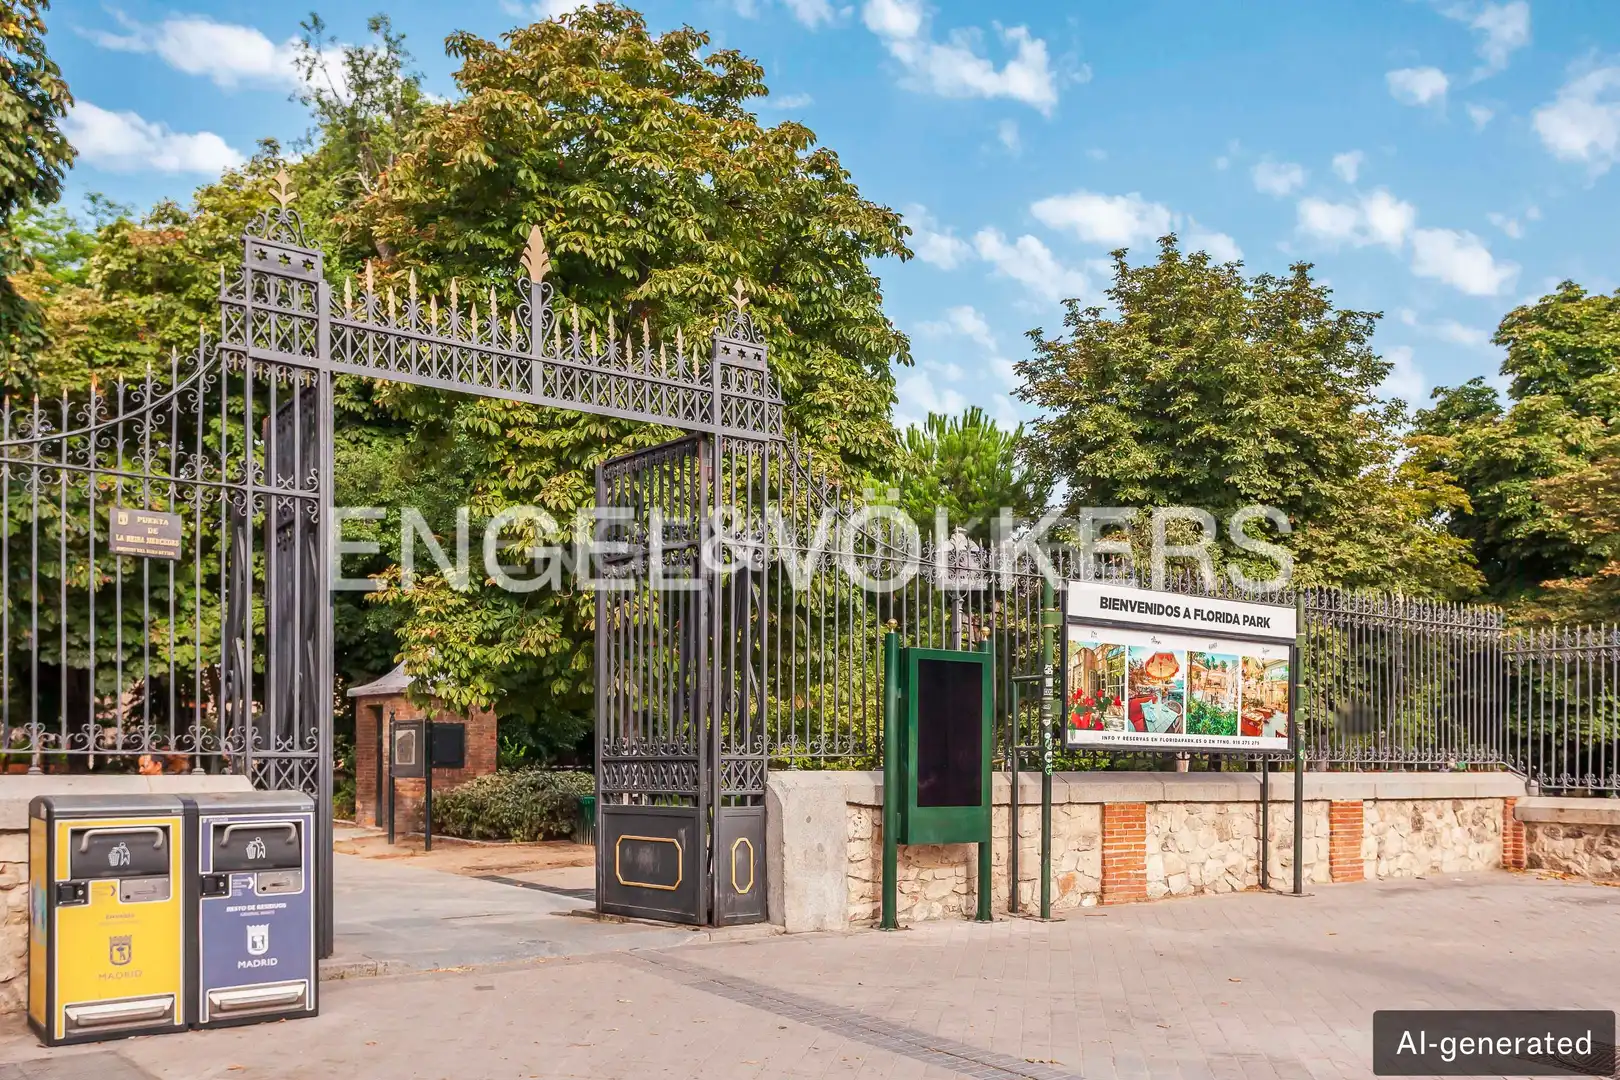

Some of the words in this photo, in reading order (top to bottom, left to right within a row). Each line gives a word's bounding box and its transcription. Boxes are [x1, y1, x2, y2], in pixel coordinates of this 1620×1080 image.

[137, 516, 169, 526] PUERTA
[147, 527, 159, 535] DE
[115, 533, 124, 541] LA
[1099, 596, 1181, 618] BIENVENIDOS
[1182, 607, 1192, 619] A
[1193, 609, 1241, 626] FLORIDA
[1242, 614, 1271, 629] PARK
[237, 957, 278, 970] MADRID
[98, 969, 143, 981] MADRID
